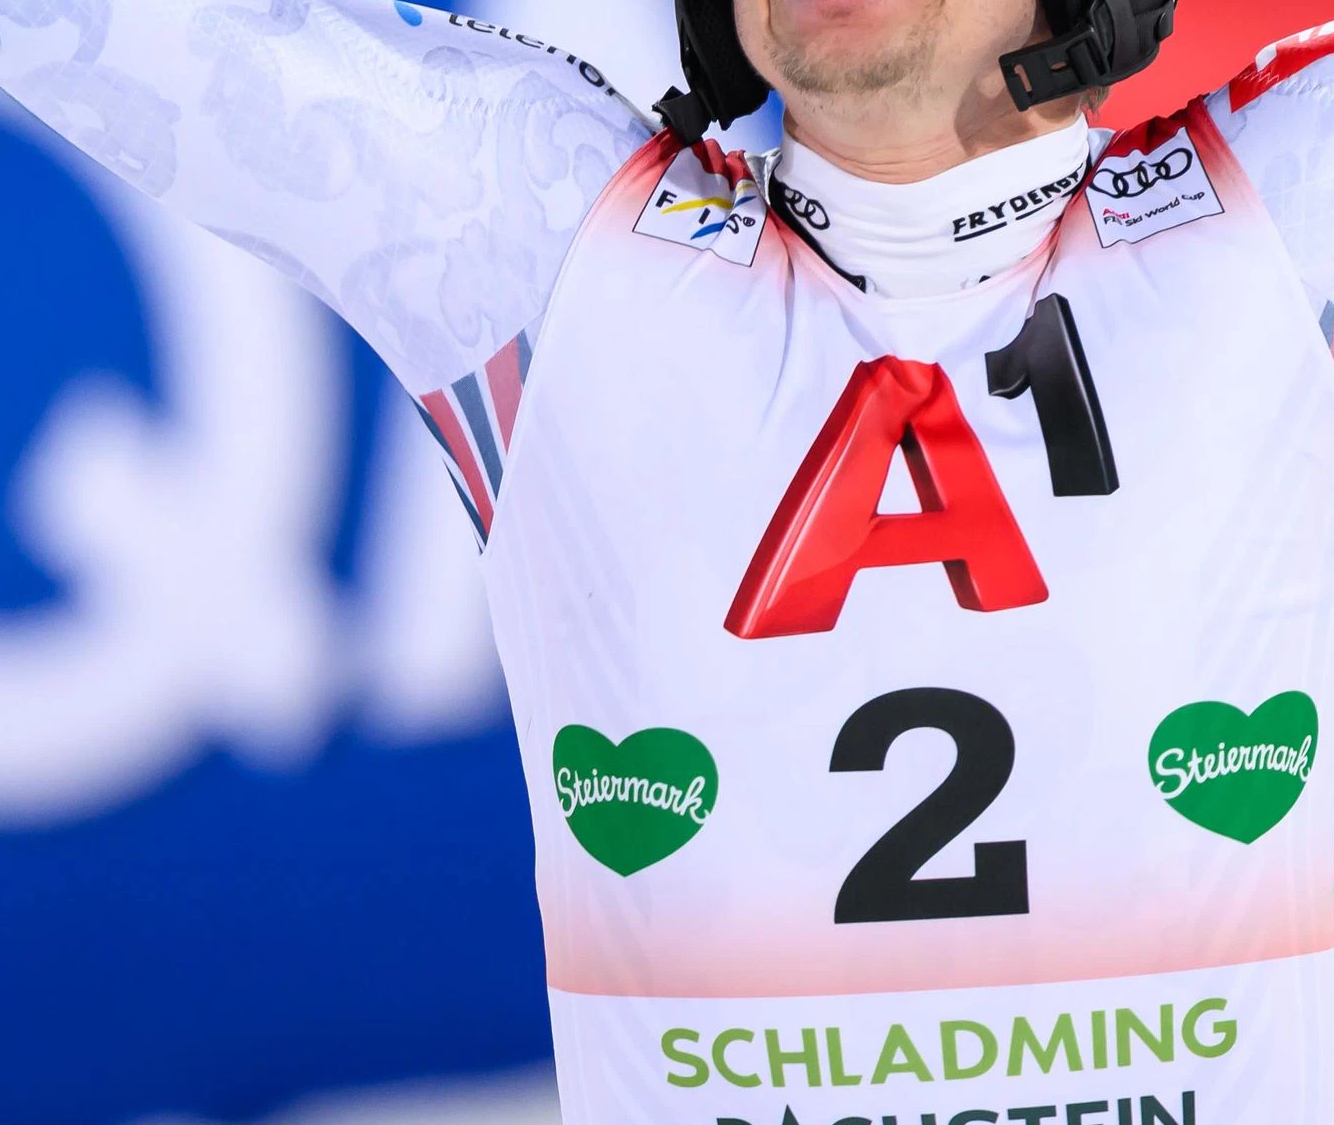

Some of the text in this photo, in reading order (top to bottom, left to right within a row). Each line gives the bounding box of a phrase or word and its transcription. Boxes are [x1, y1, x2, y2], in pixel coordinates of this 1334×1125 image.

[1144, 196, 1181, 218] World
[557, 767, 711, 825] Steiermark
[1155, 734, 1312, 800] Steiermark
[828, 686, 1030, 926] 2
[661, 997, 1238, 1089] SCHLADMING
